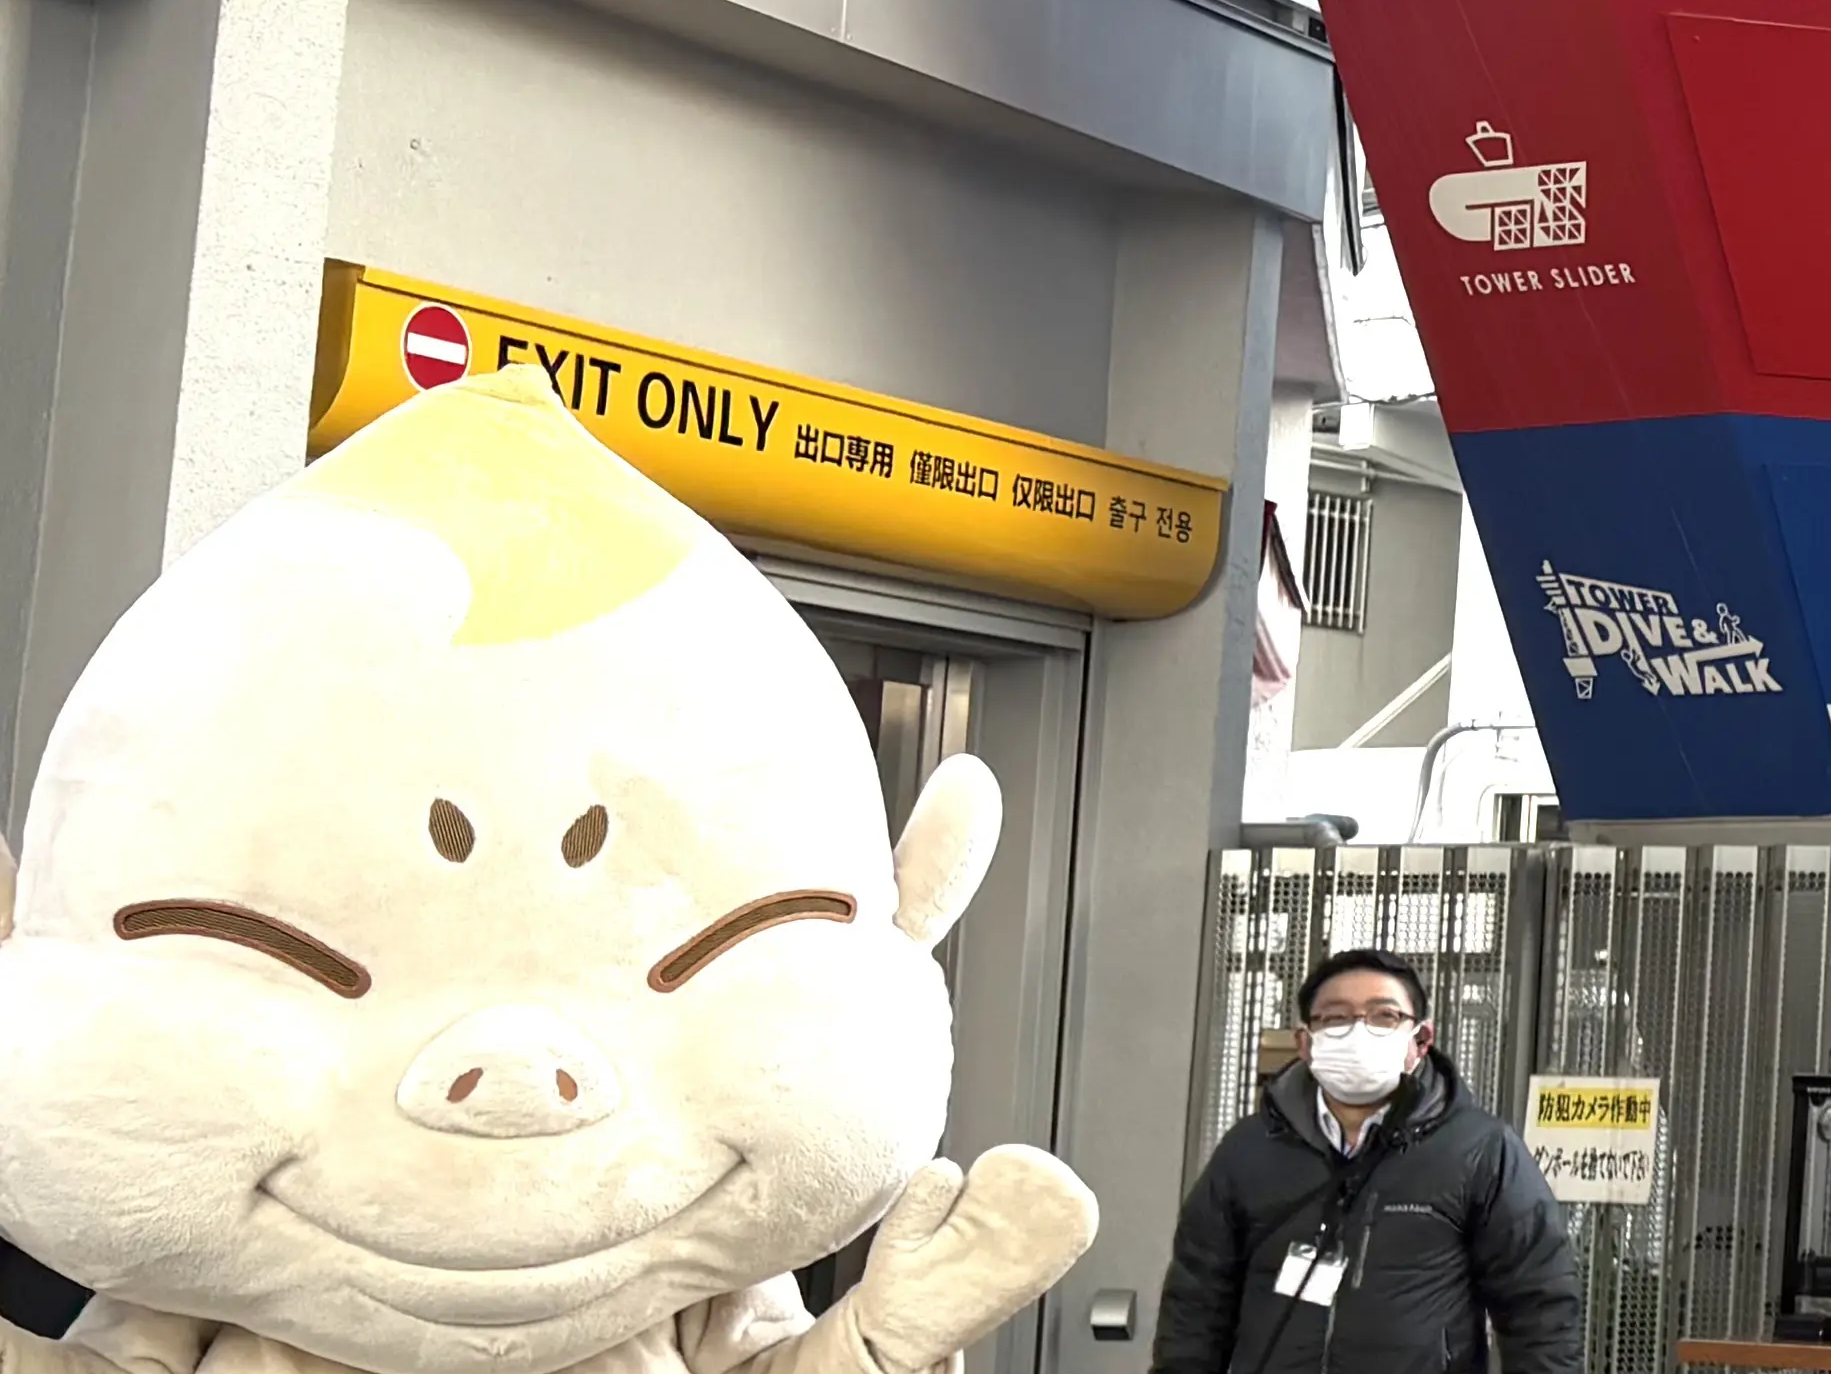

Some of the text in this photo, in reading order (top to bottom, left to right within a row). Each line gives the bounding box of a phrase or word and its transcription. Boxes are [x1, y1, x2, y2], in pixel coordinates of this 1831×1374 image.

[1460, 262, 1636, 297] TOWER SLIDER
[497, 335, 780, 452] EXIT ONLY
[794, 424, 894, 480] 出口専用
[909, 448, 999, 502] 僅限出口
[1012, 473, 1096, 522] 仅限出口
[1108, 495, 1193, 544] 출구 전용
[1565, 579, 1673, 615] TOWER
[1575, 607, 1720, 657] DIVE &
[1650, 651, 1783, 696] WALK
[1537, 1093, 1651, 1124] 防犯カメラ作動中
